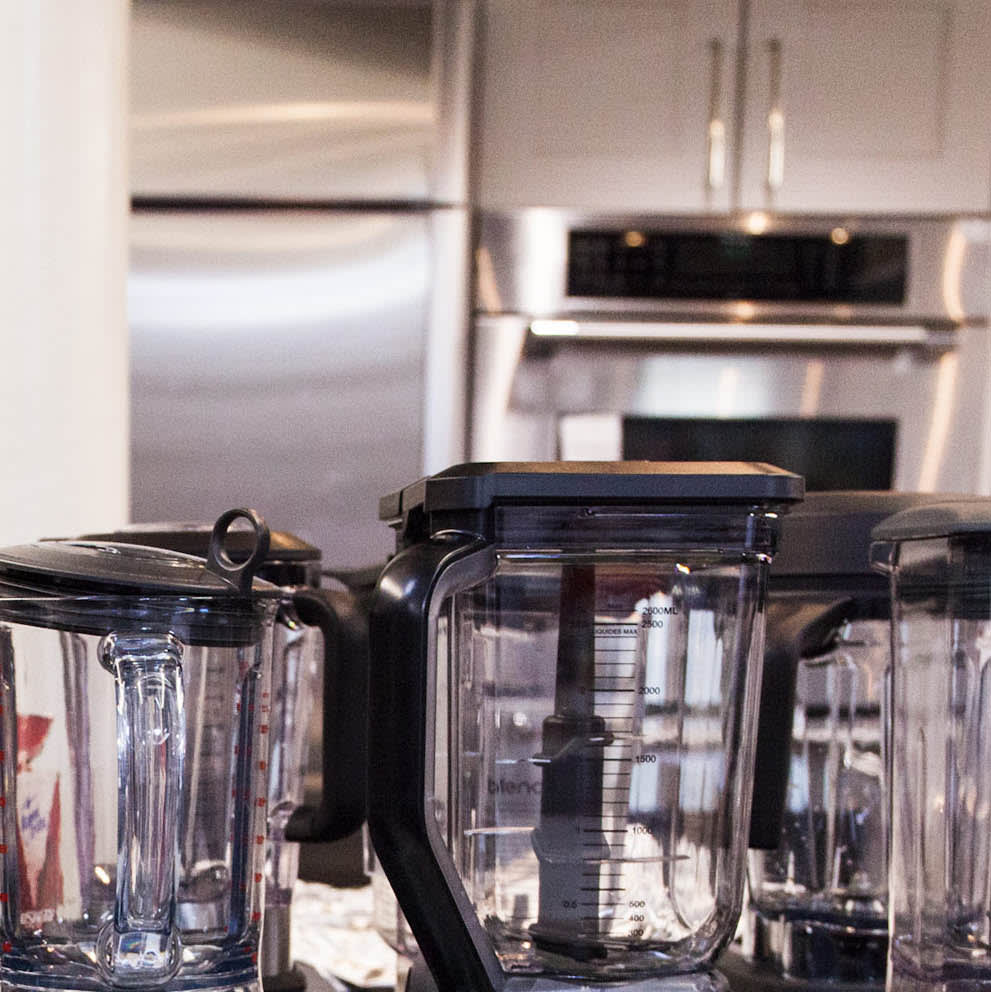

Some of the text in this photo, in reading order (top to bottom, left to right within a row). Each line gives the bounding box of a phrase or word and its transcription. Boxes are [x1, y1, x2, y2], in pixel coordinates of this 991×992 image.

[641, 620, 663, 628] 2500
[639, 687, 660, 695] 2000
[635, 755, 657, 763] 1500
